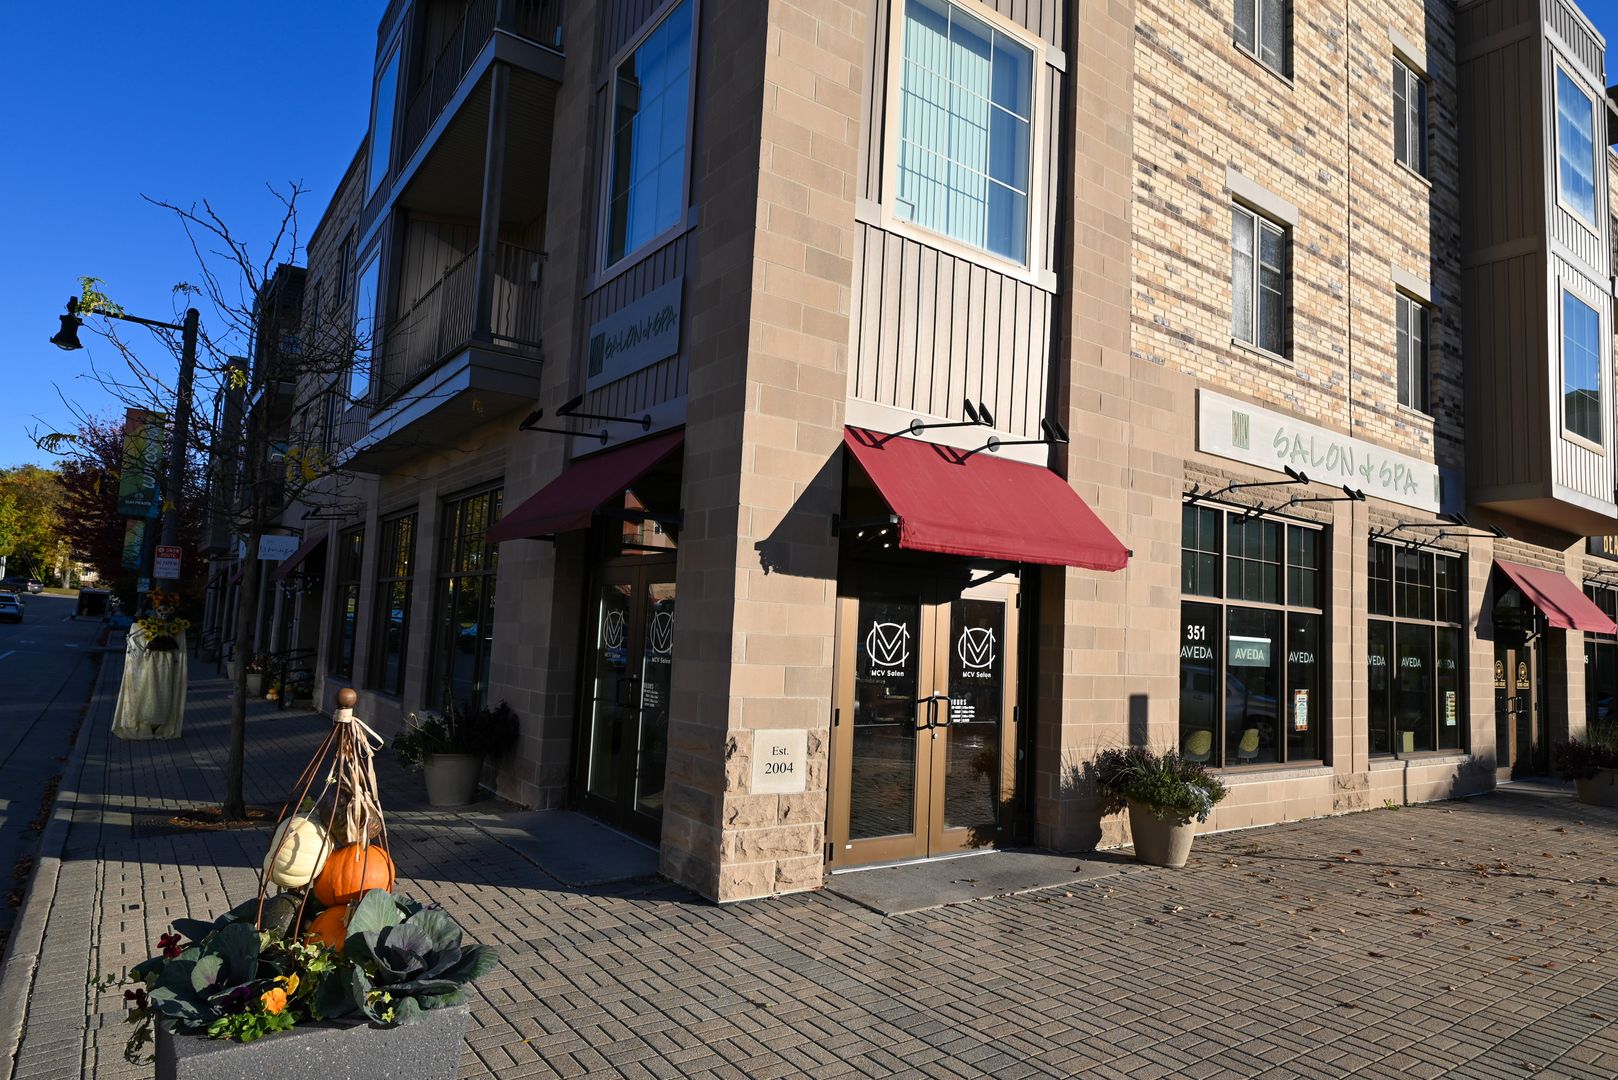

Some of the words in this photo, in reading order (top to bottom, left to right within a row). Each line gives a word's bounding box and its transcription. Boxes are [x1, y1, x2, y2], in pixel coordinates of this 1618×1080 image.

[604, 319, 642, 359] SALON
[653, 304, 677, 336] SPA
[1273, 427, 1354, 477] SALON
[1379, 460, 1418, 495] SPA
[1187, 624, 1206, 641] 351
[1179, 645, 1213, 659] AVEDA
[1234, 647, 1264, 660] AVEDA
[1288, 651, 1314, 664] AVEDA
[1367, 655, 1386, 666] VEDA
[1401, 657, 1421, 668] AVEDA
[772, 746, 789, 756] Est.
[765, 762, 793, 774] 2004
